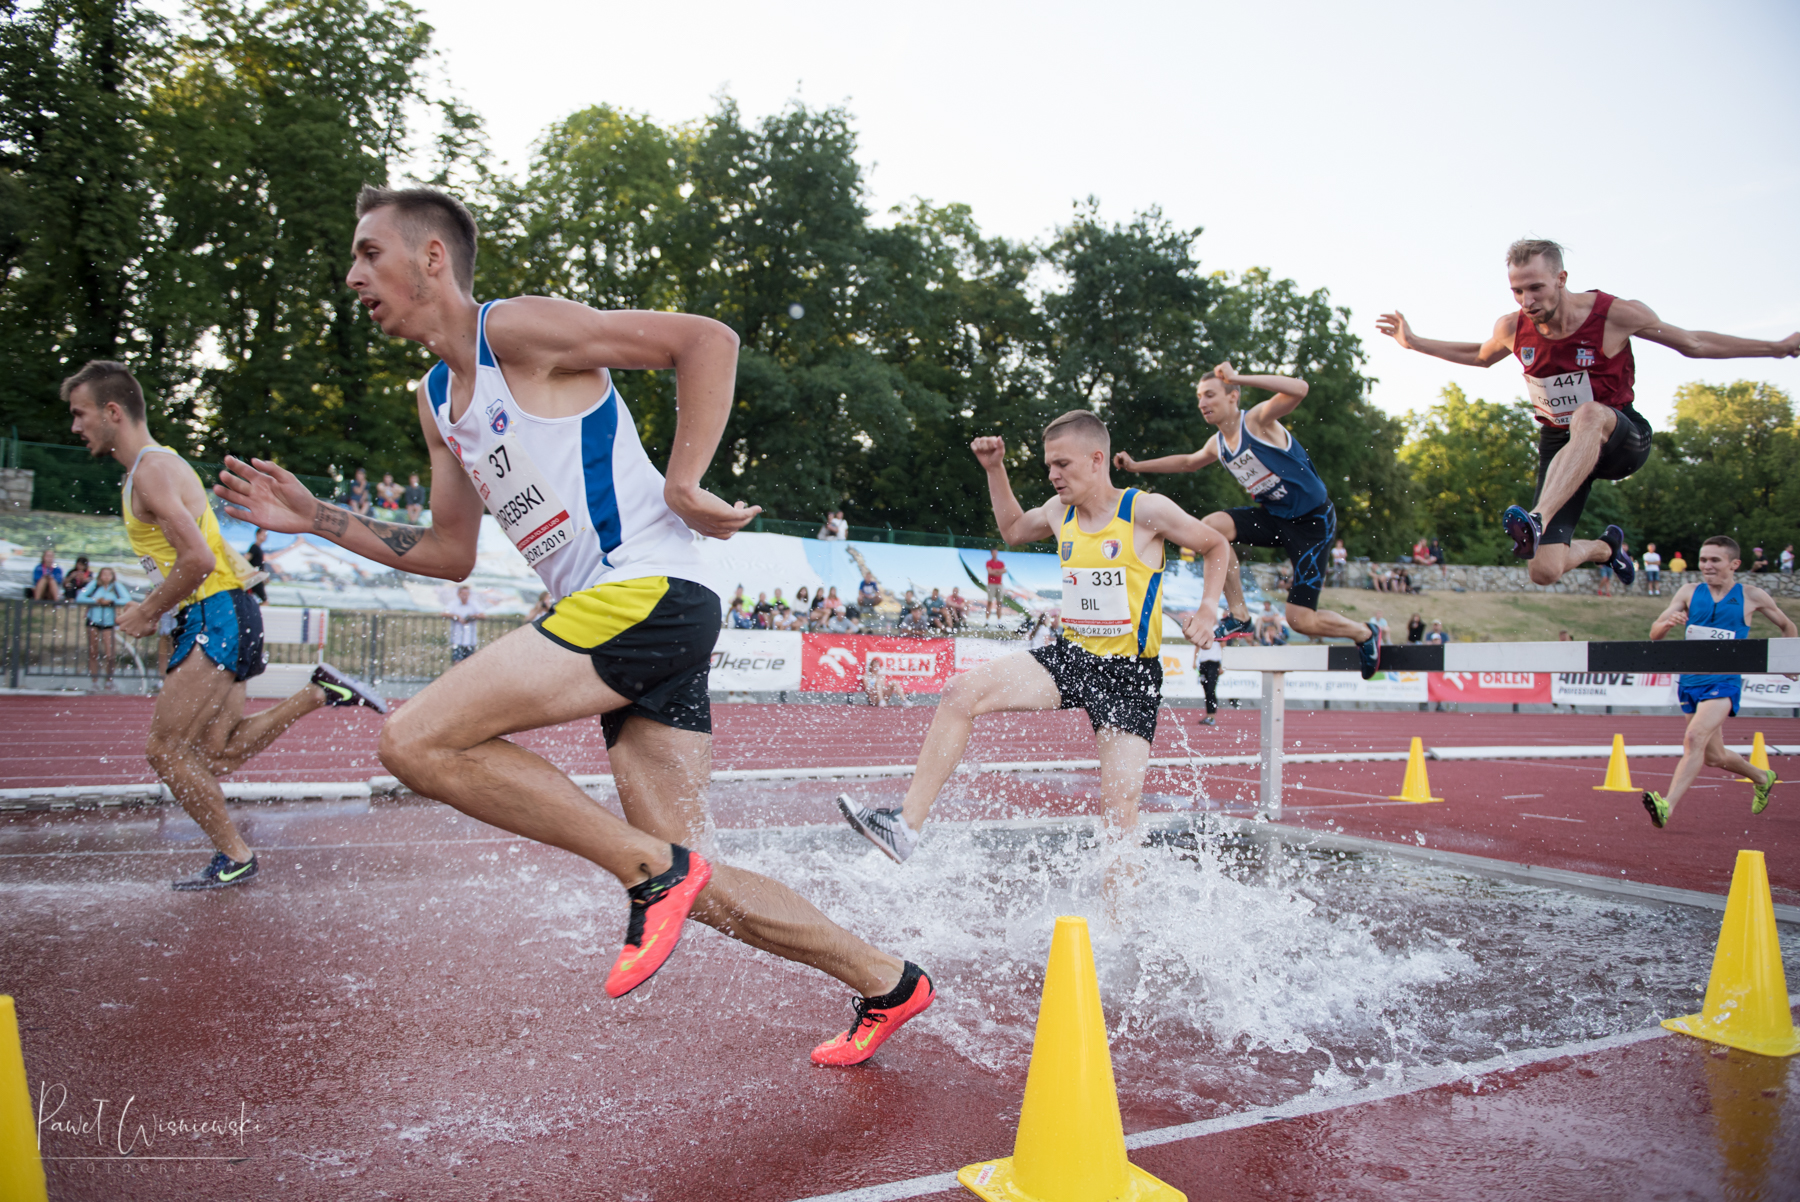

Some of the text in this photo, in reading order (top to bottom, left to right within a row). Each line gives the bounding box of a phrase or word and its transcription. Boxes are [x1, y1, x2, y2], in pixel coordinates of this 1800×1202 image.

[1553, 372, 1585, 388] 447
[489, 445, 512, 479] 37
[1233, 453, 1253, 469] 164
[1238, 468, 1258, 484] ELAK
[541, 530, 566, 552] 2019
[1091, 571, 1124, 587] 331
[1081, 598, 1100, 611] BIL
[1102, 627, 1122, 635] 2019
[1710, 629, 1731, 640] 261
[1482, 672, 1530, 684] ORLEN
[1741, 678, 1791, 695] kęcie
